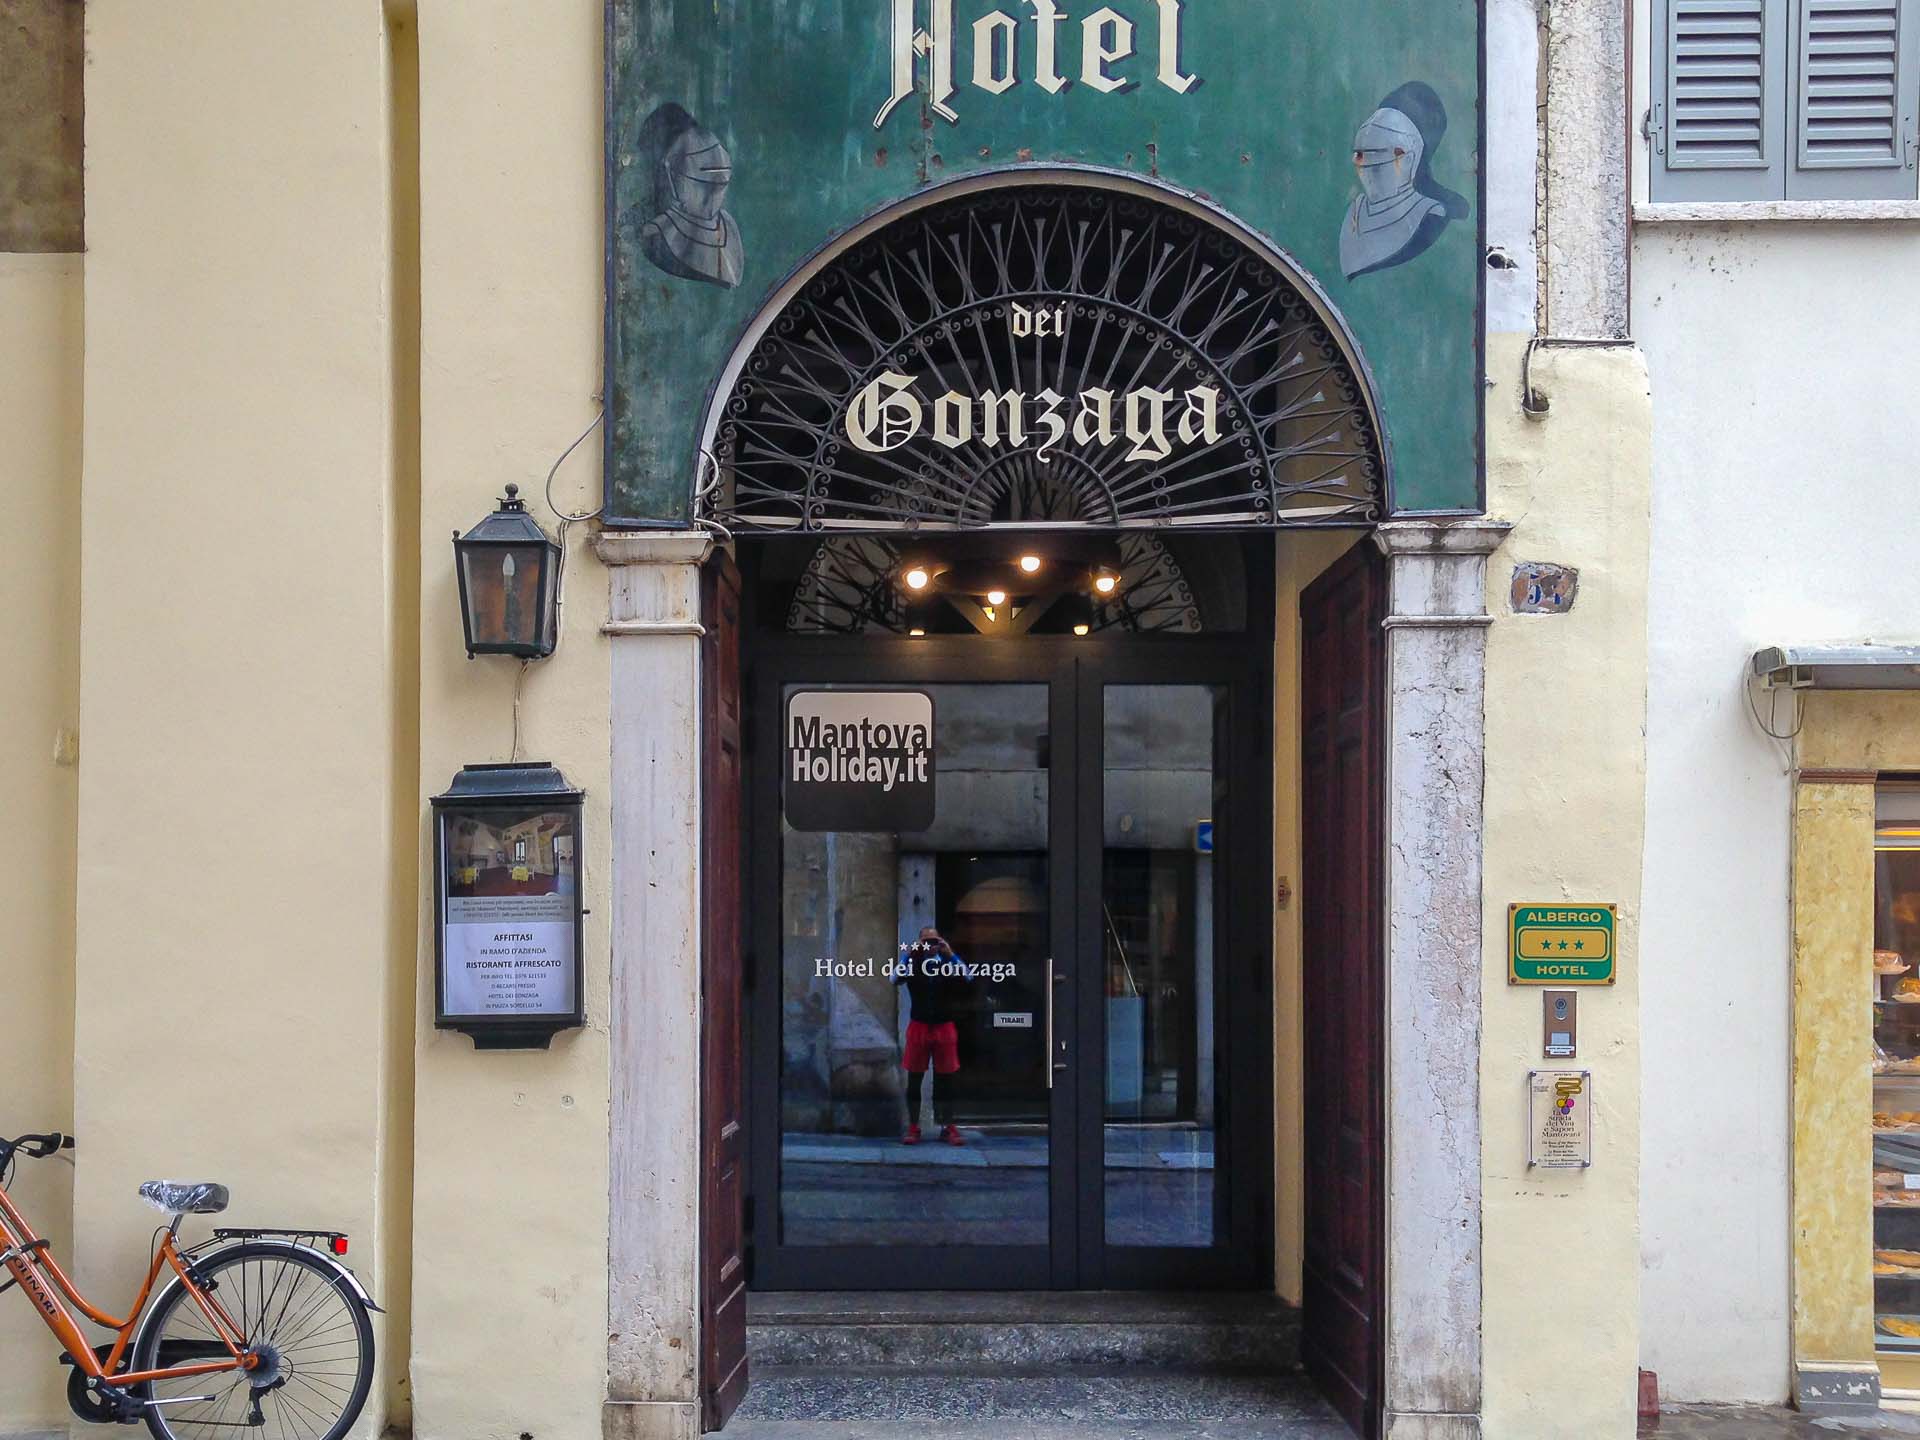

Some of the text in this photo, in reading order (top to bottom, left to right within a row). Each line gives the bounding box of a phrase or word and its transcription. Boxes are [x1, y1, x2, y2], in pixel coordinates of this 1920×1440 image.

[873, 0, 1204, 129] Hotel
[1012, 300, 1067, 338] dei
[845, 371, 1223, 464] Gonzaga
[792, 715, 929, 750] Mantova
[792, 747, 928, 791] Holiday.it
[1526, 912, 1602, 922] ALBERGO
[494, 934, 533, 942] AFFITTASI
[466, 960, 562, 969] RISTORANTE AFFRESCATO
[814, 957, 1016, 983] Hotel dei Gonzaga
[1536, 965, 1589, 975] HOTEL
